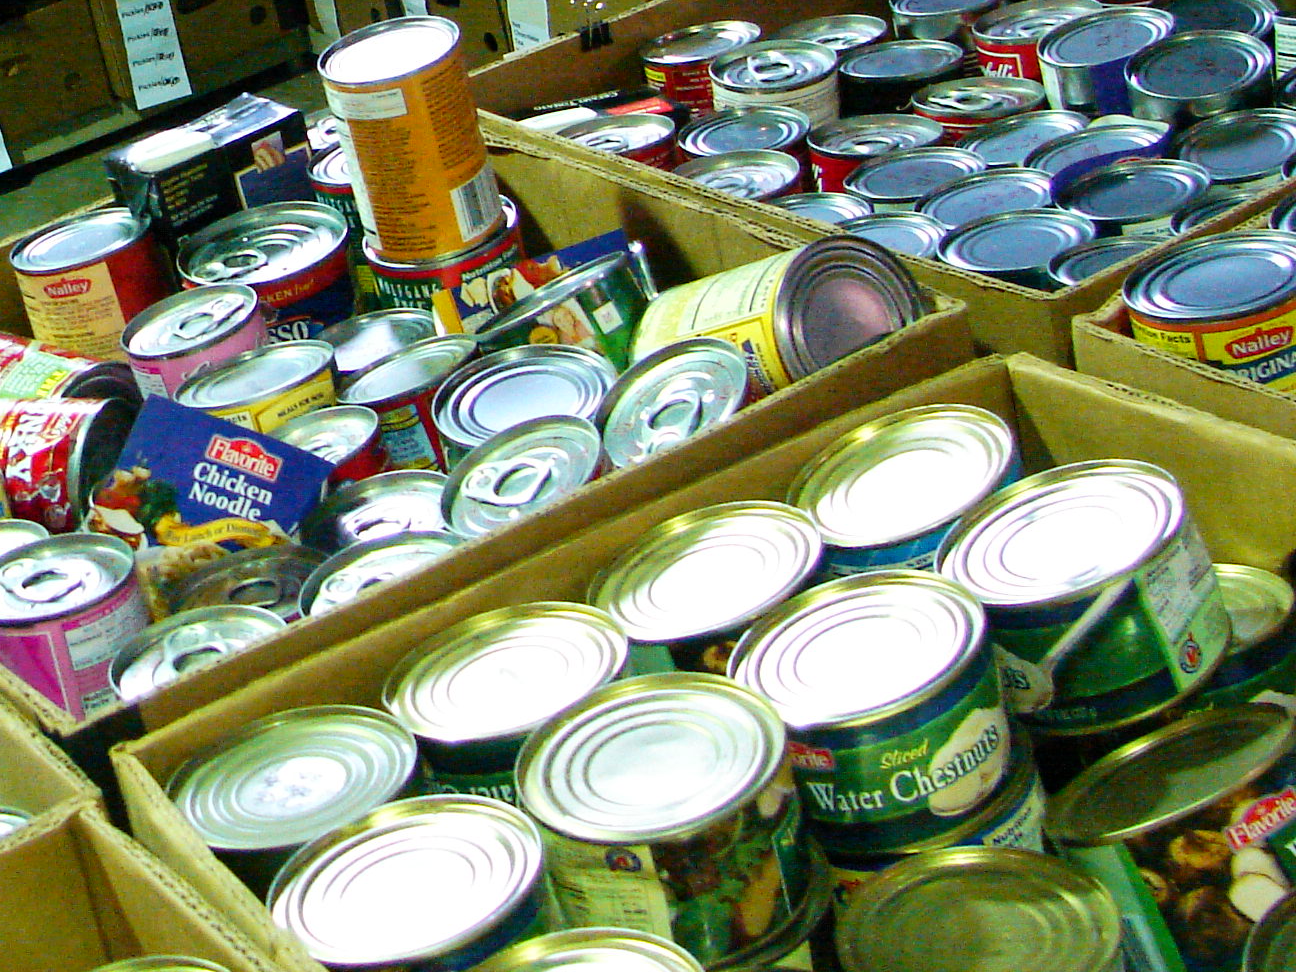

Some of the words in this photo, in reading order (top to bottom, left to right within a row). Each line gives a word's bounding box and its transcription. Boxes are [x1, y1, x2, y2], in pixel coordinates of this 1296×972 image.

[47, 282, 88, 296] Nalley
[1161, 332, 1191, 344] Facts
[1230, 330, 1290, 356] Nalley
[210, 440, 275, 477] Flavorite
[188, 482, 261, 522] Noodle
[193, 462, 273, 506] Chicken
[806, 782, 883, 812] Water
[890, 725, 999, 802] Chestnuts
[880, 739, 929, 770] Sliced
[1228, 797, 1295, 847] Flavorite
